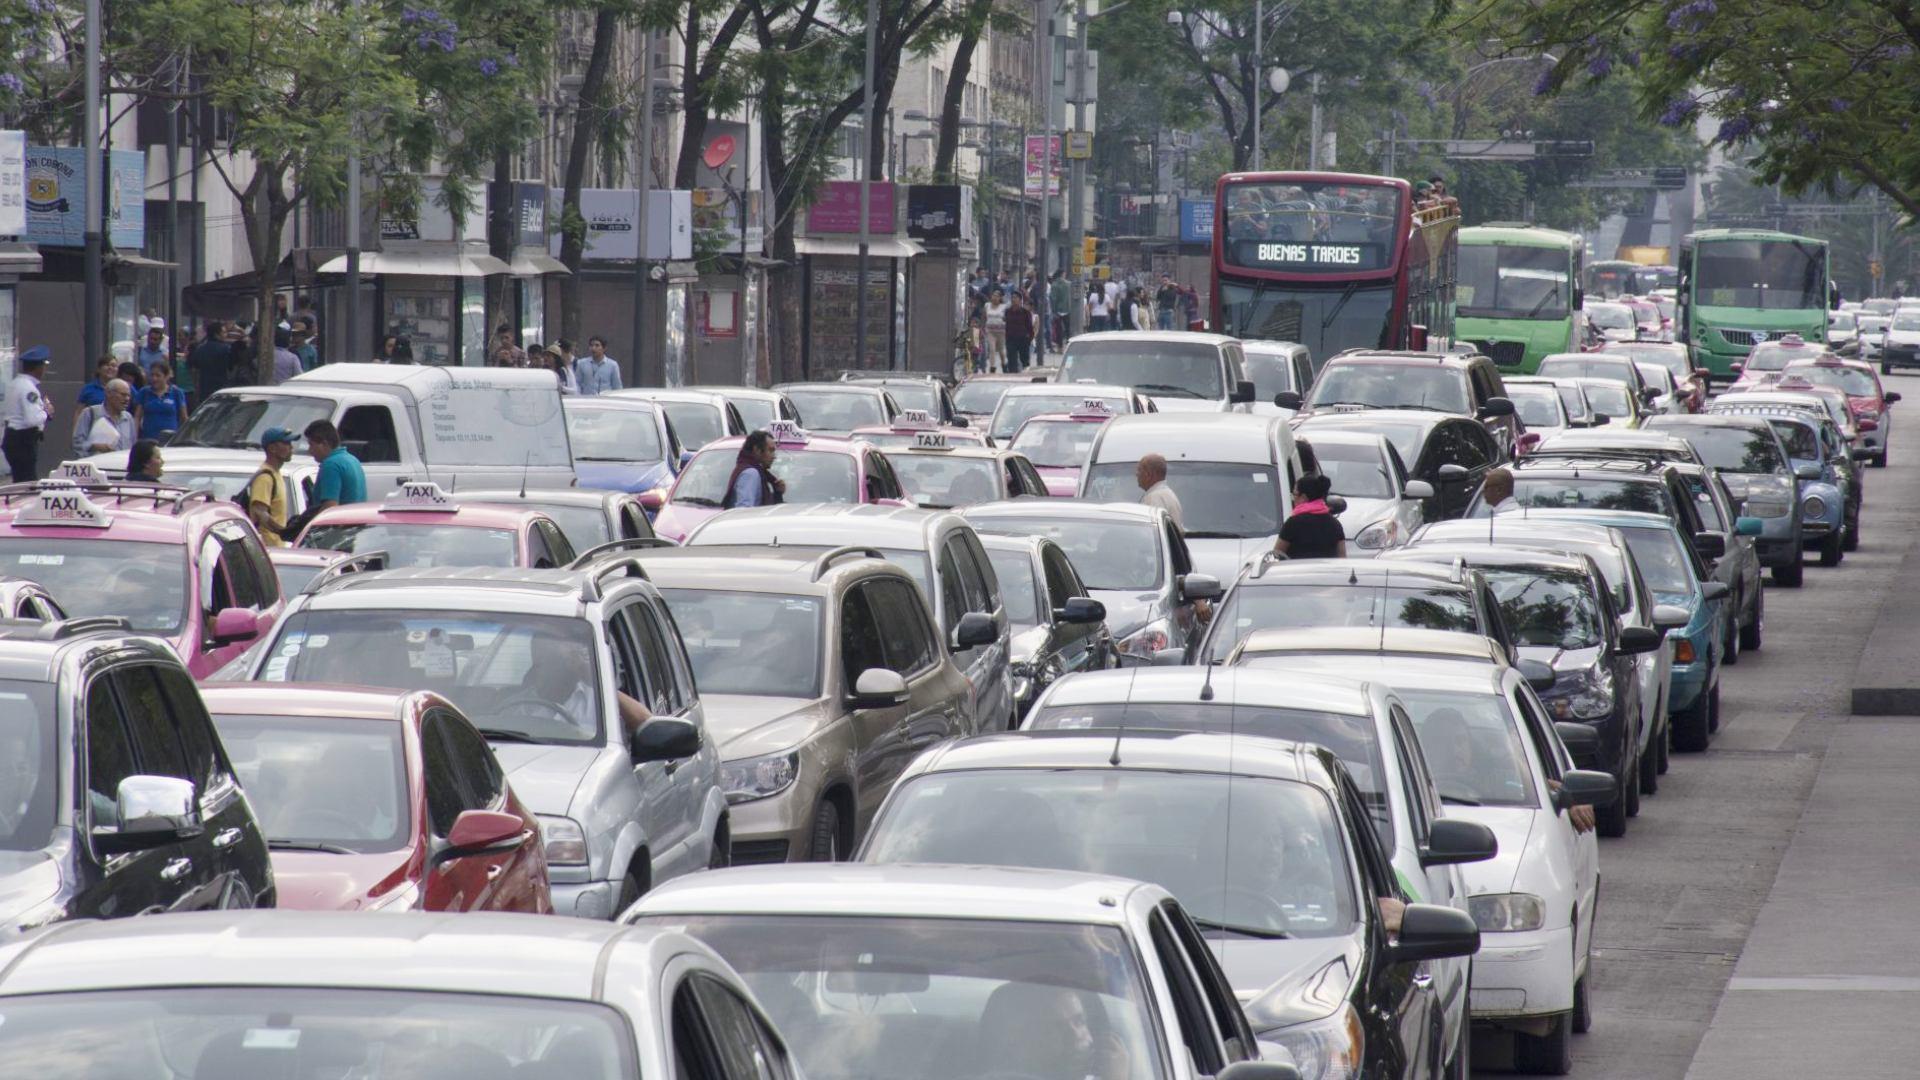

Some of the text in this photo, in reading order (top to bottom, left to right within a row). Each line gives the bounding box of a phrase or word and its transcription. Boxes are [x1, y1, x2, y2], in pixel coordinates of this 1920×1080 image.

[1258, 243, 1360, 264] BUENAS TARDES
[1084, 401, 1104, 409] TAXI
[905, 411, 927, 422] TAXI
[770, 423, 794, 433] TAXI
[917, 434, 946, 447] TAXI
[63, 464, 92, 477] TAXI
[403, 486, 434, 498] TAXI
[41, 496, 79, 511] TAXI
[51, 510, 75, 518] LIBRE
